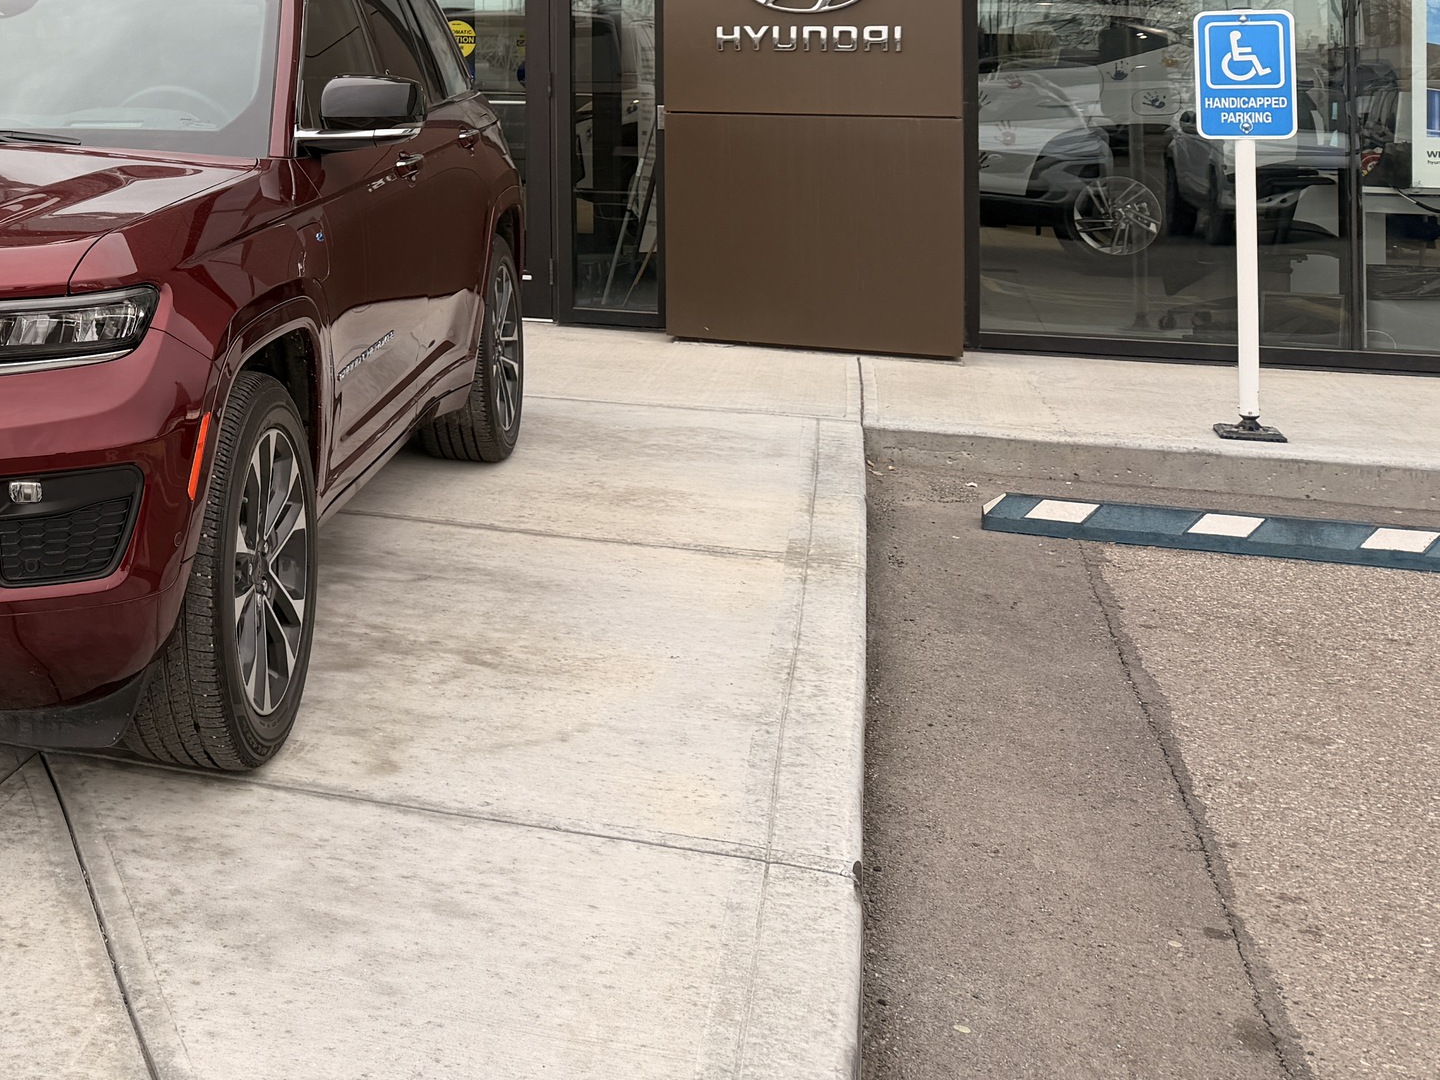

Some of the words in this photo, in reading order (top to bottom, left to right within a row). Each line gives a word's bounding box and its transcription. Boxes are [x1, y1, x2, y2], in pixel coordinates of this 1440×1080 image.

[716, 25, 903, 52] HYUNDAI
[1204, 97, 1288, 109] HANDICAPPED
[1220, 111, 1272, 124] PARKING
